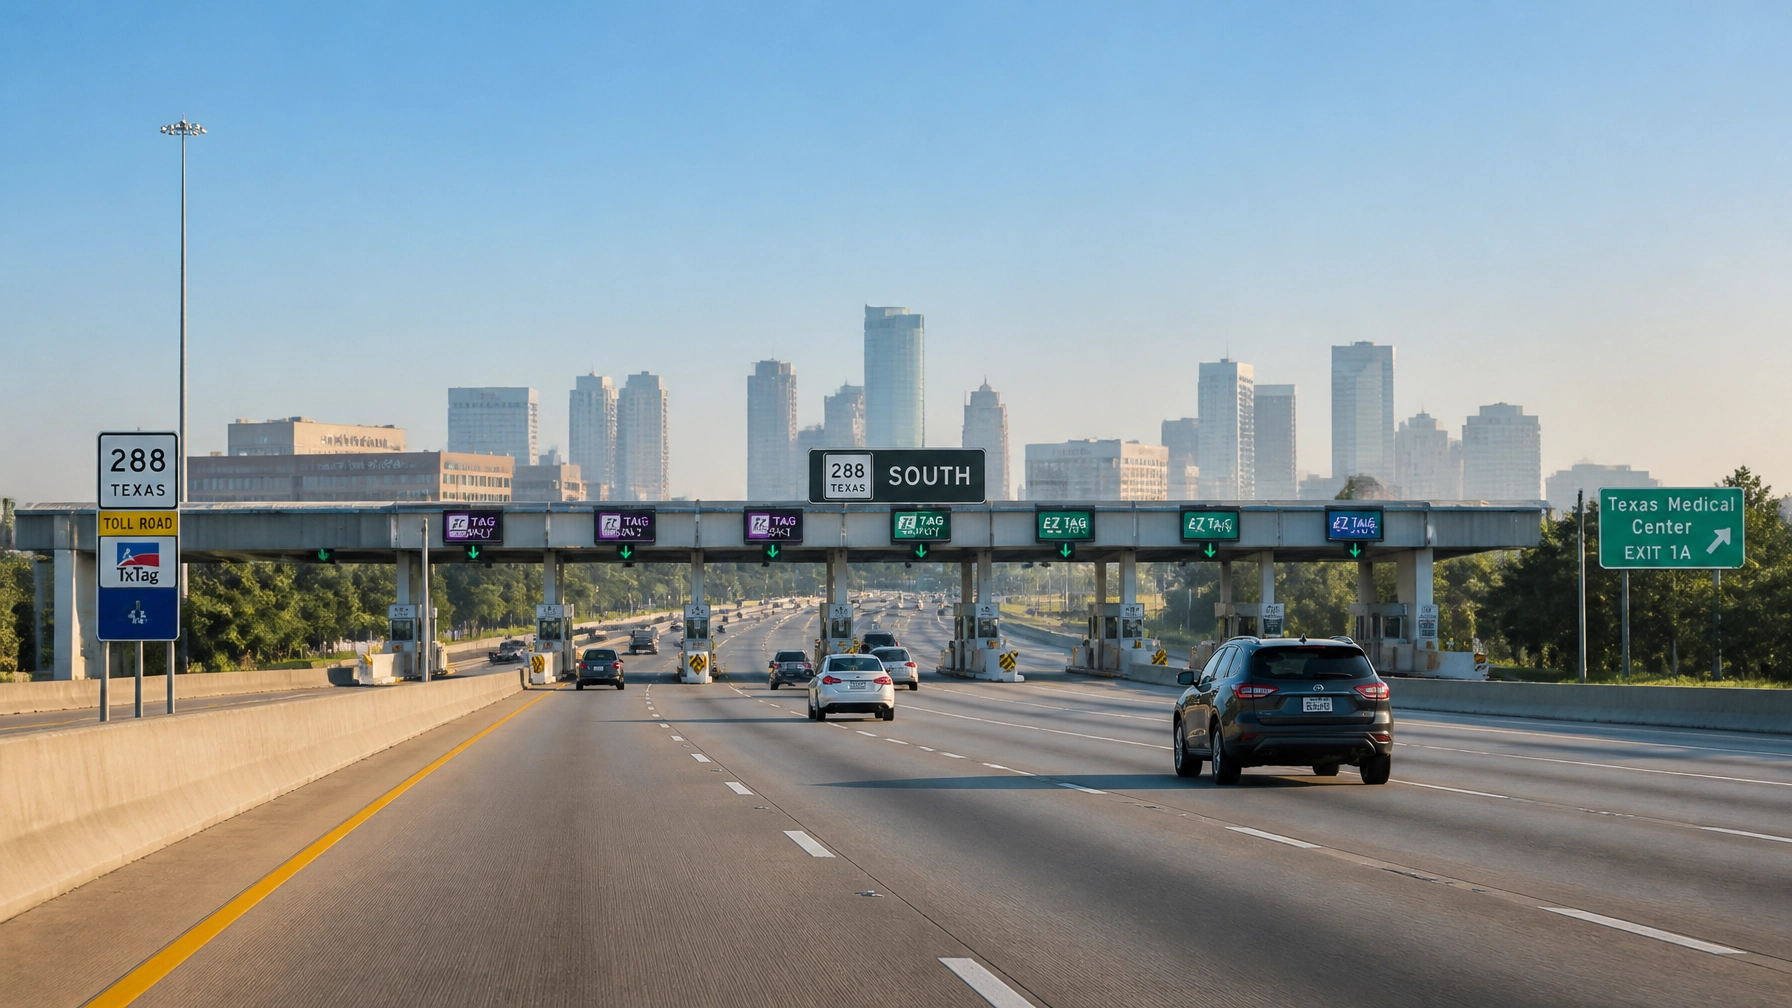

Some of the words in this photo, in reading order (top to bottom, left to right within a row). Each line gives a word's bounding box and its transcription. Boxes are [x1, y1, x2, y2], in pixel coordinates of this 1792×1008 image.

[110, 448, 166, 473] 288
[831, 463, 865, 479] 288
[888, 465, 970, 486] SOUTH
[110, 484, 166, 497] TEXAS
[830, 483, 866, 493] TEXAS
[1608, 496, 1658, 512] Texas
[1668, 496, 1735, 512] Medical
[104, 517, 134, 530] TOLL
[139, 517, 173, 530] ROAD
[1043, 517, 1061, 529] EZ
[1189, 517, 1206, 529] EZ
[1632, 518, 1692, 535] Center
[1625, 545, 1662, 560] EXIT
[1670, 545, 1692, 560] 1A
[116, 567, 160, 585] TxTag
